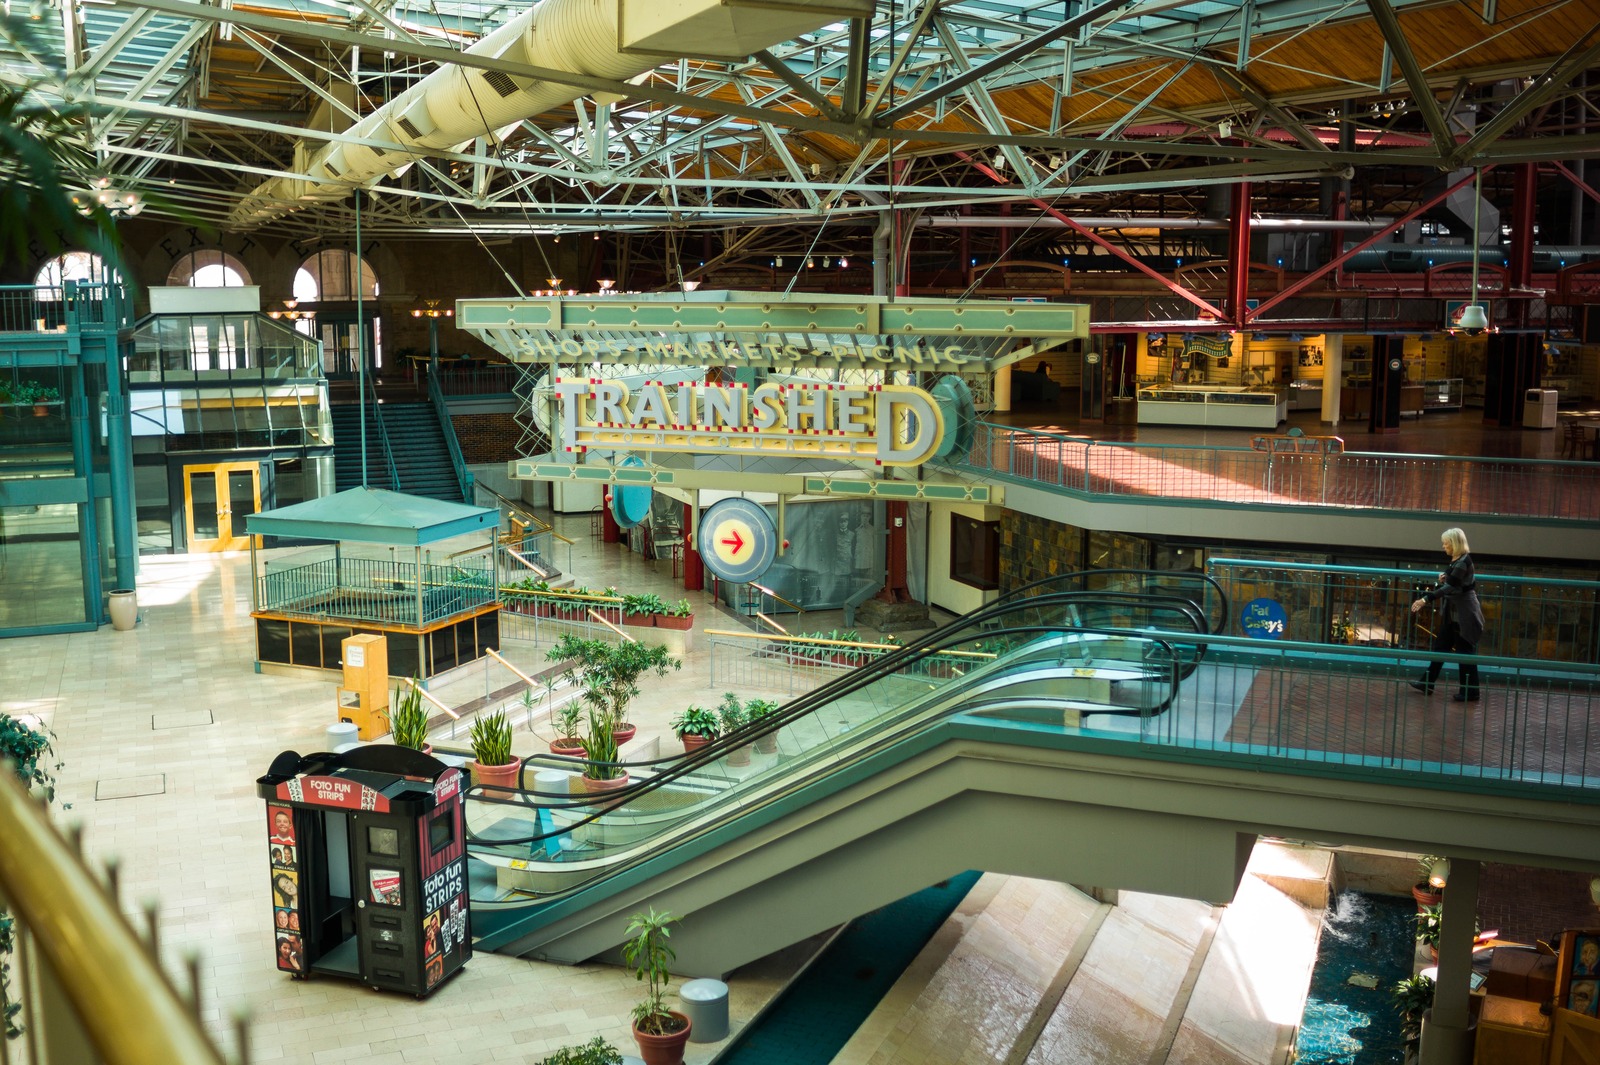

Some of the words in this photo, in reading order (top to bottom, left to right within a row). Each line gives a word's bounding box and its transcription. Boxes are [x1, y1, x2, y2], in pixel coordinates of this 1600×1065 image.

[160, 226, 256, 259] EXIT
[519, 338, 622, 358] SHOPS
[643, 340, 802, 361] MARKETS
[831, 344, 968, 364] PICNIC
[554, 379, 943, 465] TRAINSHED
[310, 780, 333, 791] FOTO
[334, 782, 352, 794] FUN
[317, 789, 345, 802] STRIPS
[423, 873, 445, 897] foto
[445, 862, 463, 882] fun
[425, 876, 463, 914] STRIPS
